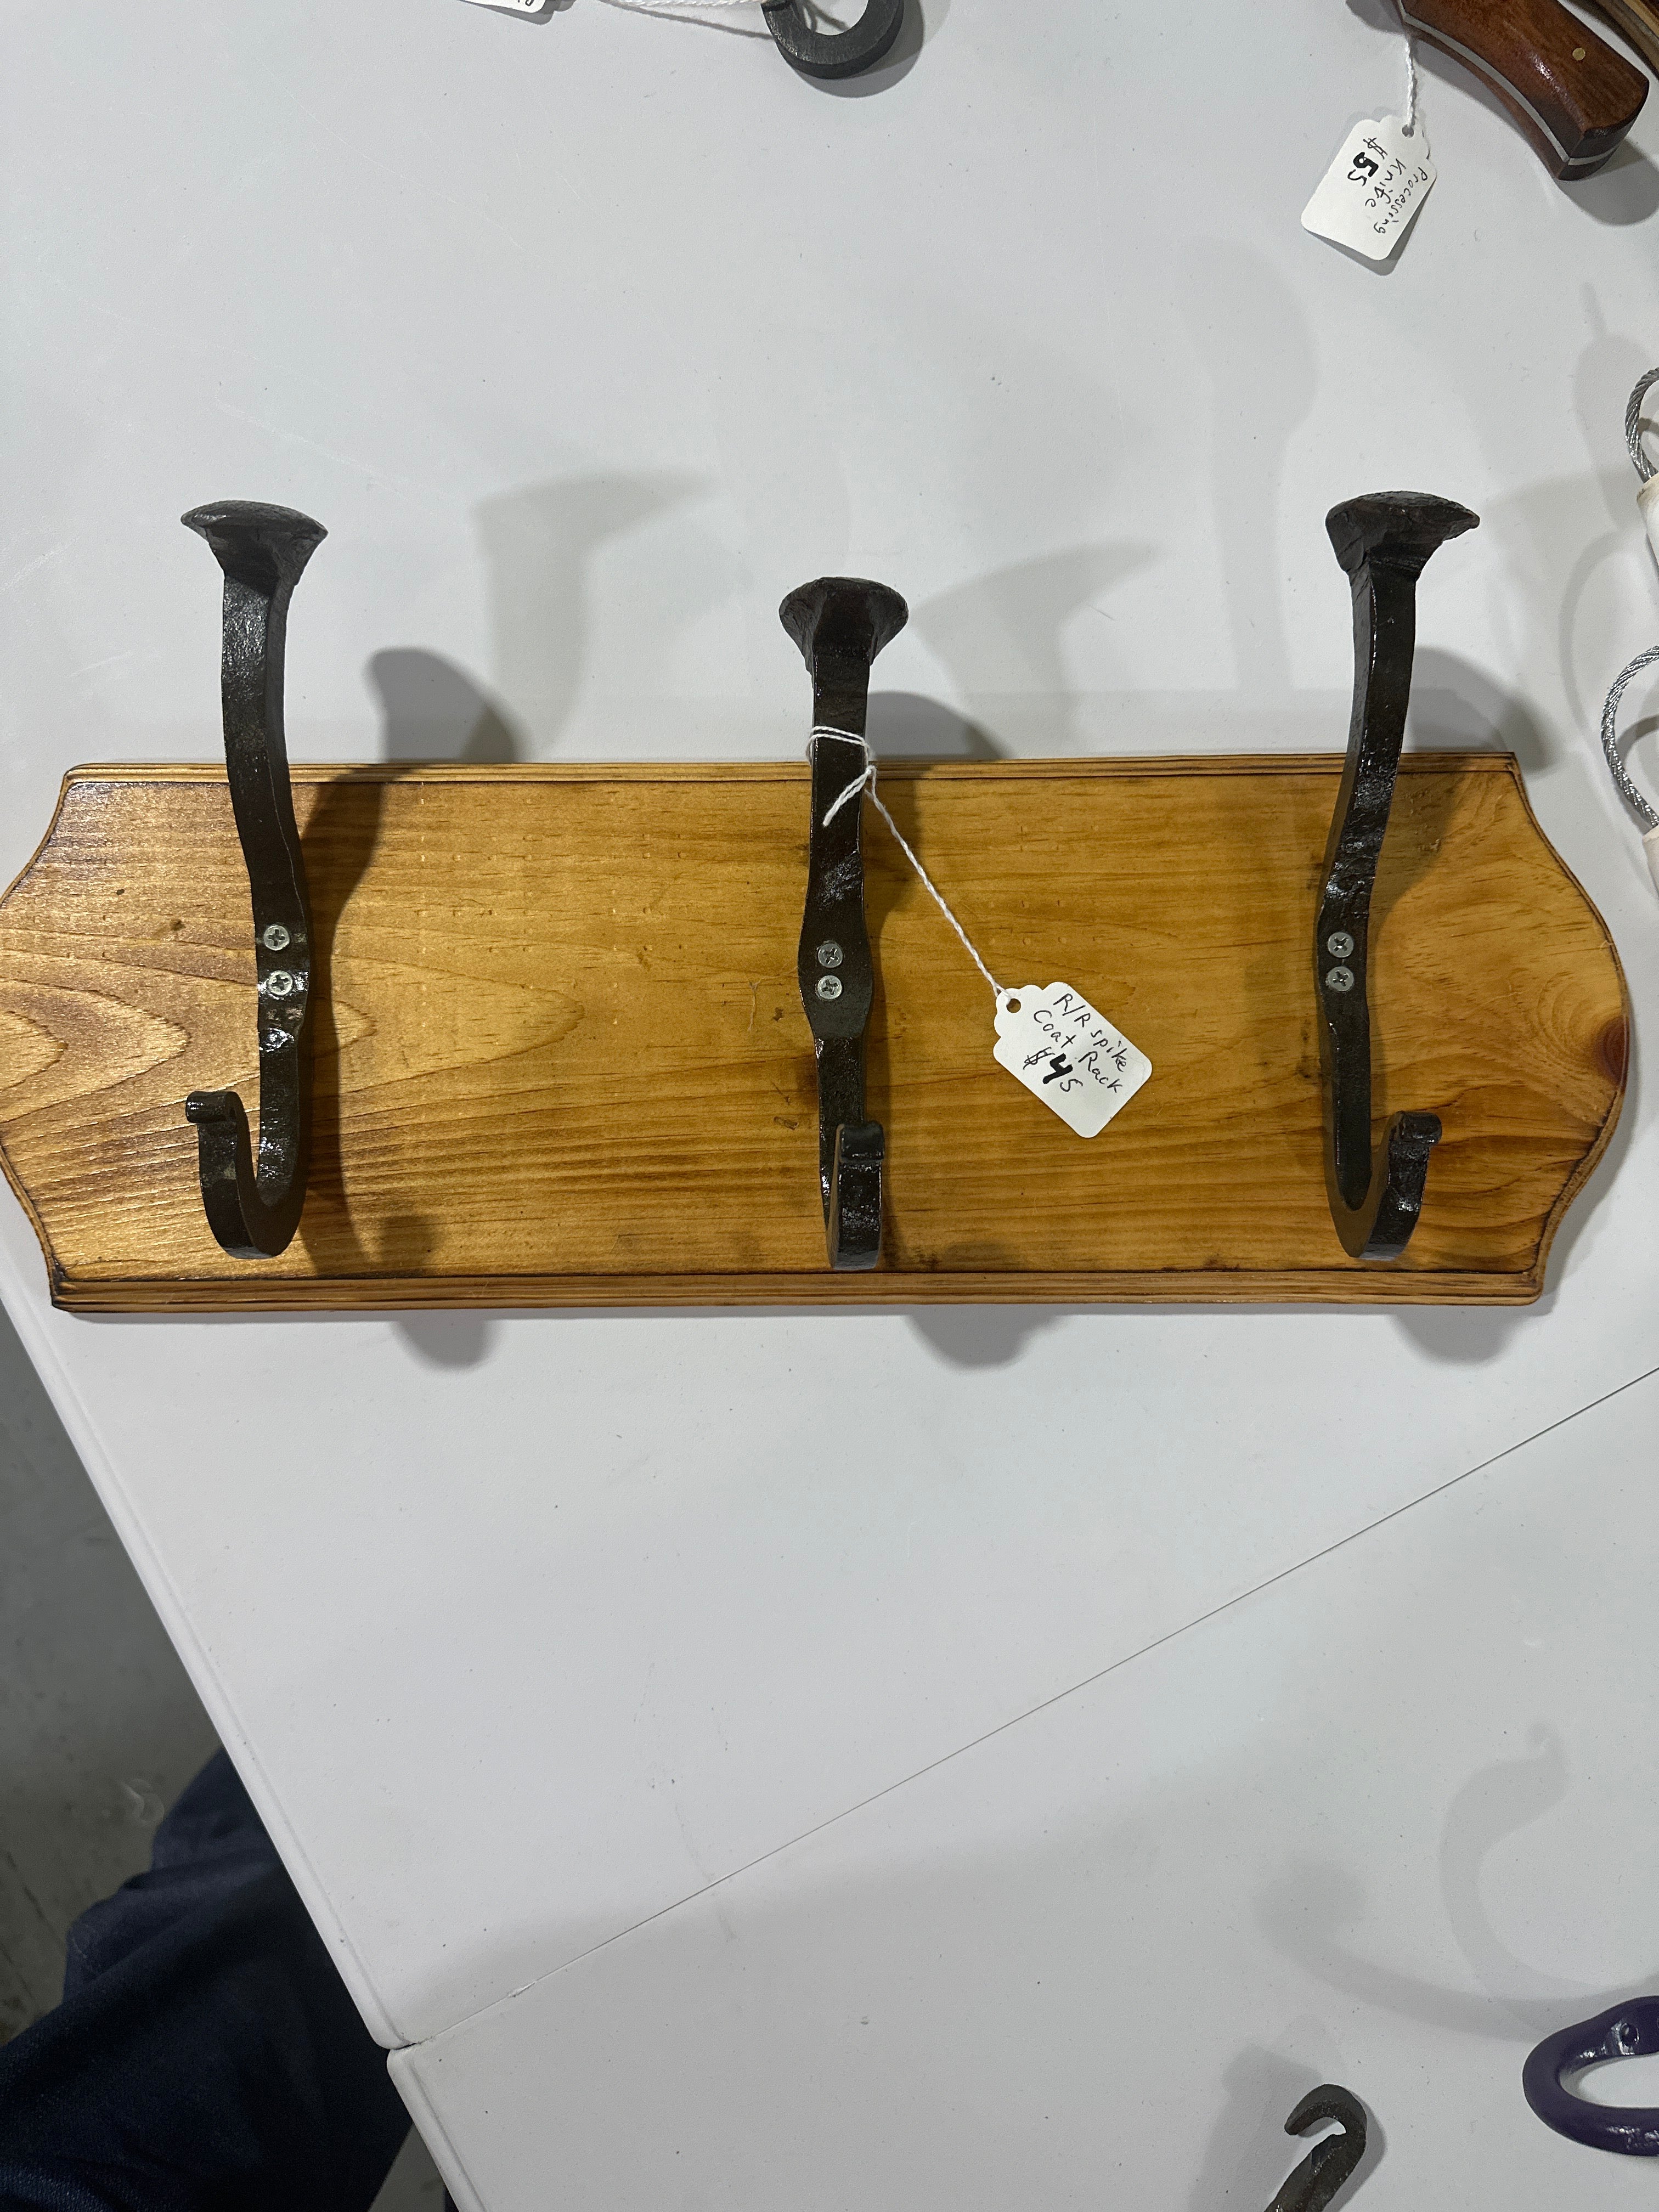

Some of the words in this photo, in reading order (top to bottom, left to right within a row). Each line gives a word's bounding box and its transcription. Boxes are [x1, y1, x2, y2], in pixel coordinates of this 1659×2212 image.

[1347, 137, 1388, 187] $55
[1364, 157, 1407, 207] Knife
[1373, 166, 1428, 234] Processing
[1033, 1009, 1076, 1048] Coat
[1078, 1051, 1123, 1093] Rack
[1053, 993, 1091, 1028] R/R
[1090, 1029, 1127, 1072] spike
[1023, 1046, 1084, 1092] $45
